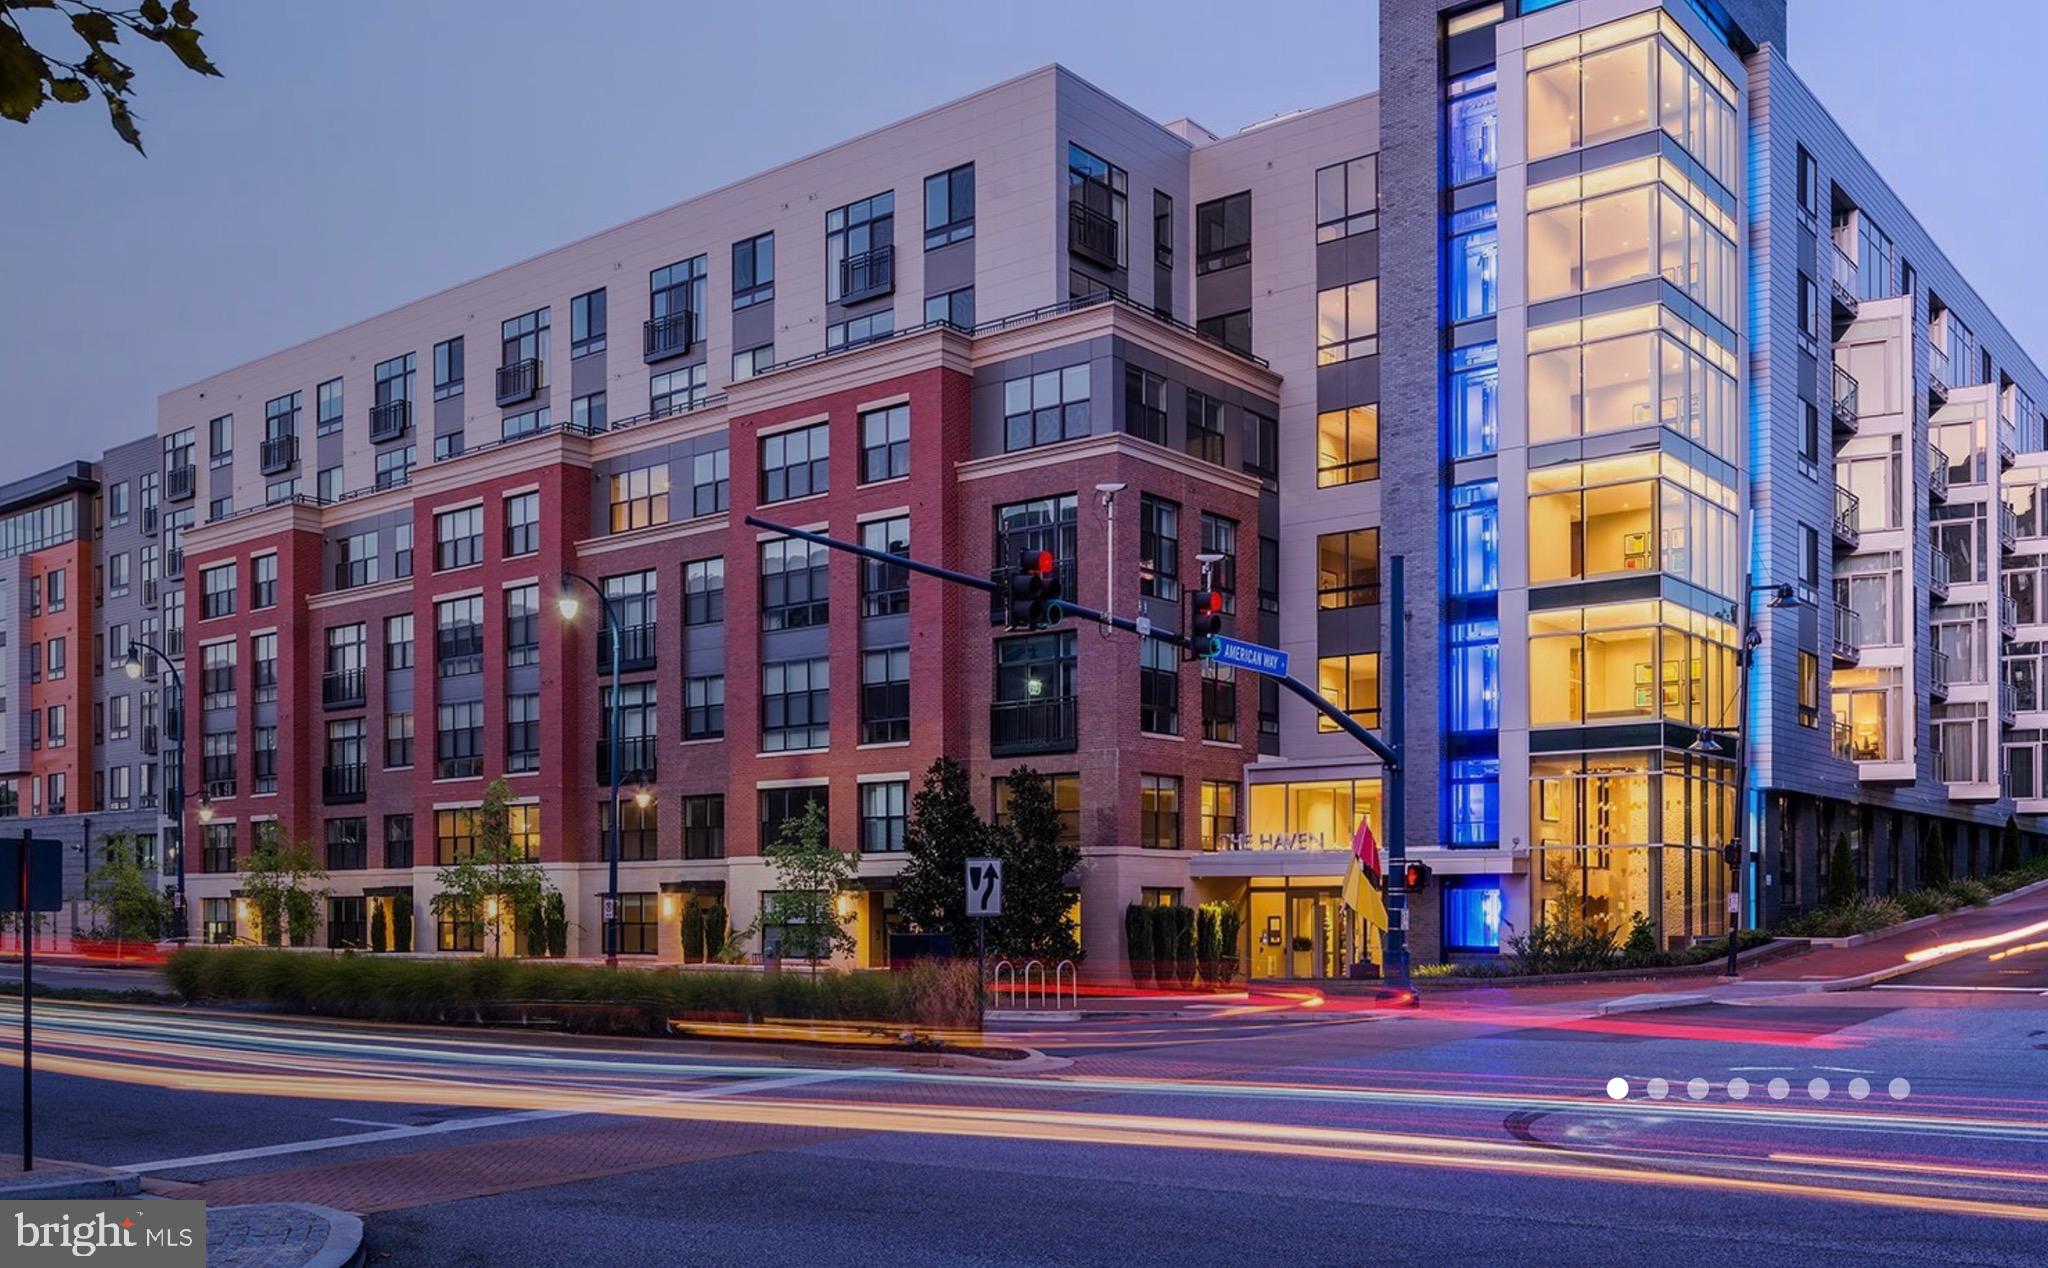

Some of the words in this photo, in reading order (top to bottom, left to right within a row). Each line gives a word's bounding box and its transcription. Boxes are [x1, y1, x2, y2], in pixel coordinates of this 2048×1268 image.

[1224, 643, 1262, 666] AMERICAN
[1263, 653, 1279, 670] WAY
[1219, 833, 1253, 851] THE
[1260, 832, 1325, 851] HAVEN
